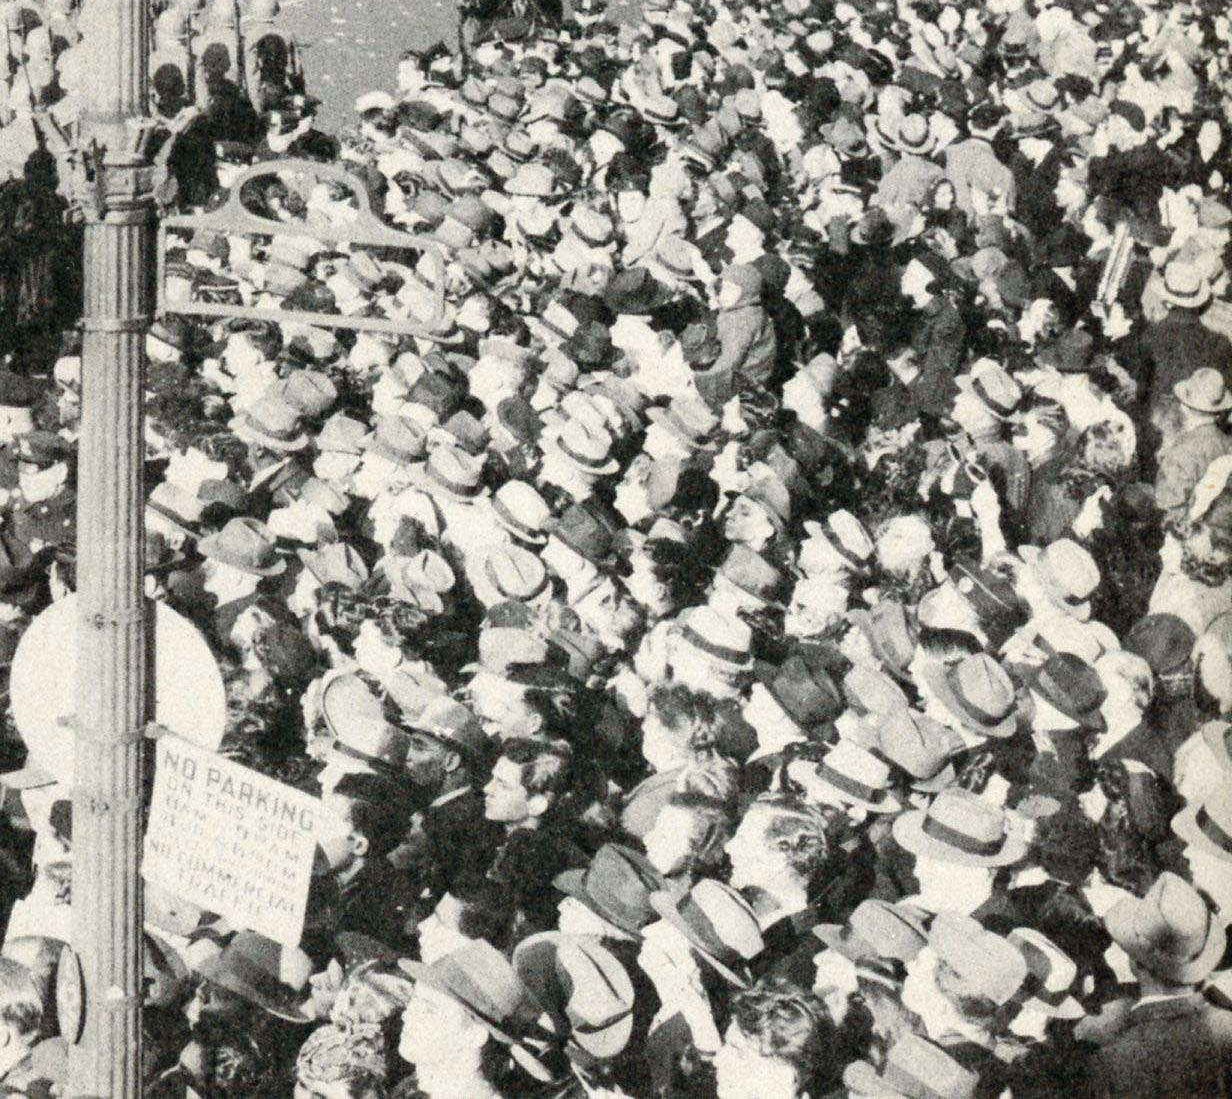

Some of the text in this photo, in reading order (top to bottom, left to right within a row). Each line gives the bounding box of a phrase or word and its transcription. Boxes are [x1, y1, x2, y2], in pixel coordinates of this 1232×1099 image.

[164, 750, 196, 781] NO
[206, 767, 313, 831] PARKING
[167, 776, 192, 797] ON
[205, 791, 245, 820] THIS
[259, 815, 303, 846] SIDE
